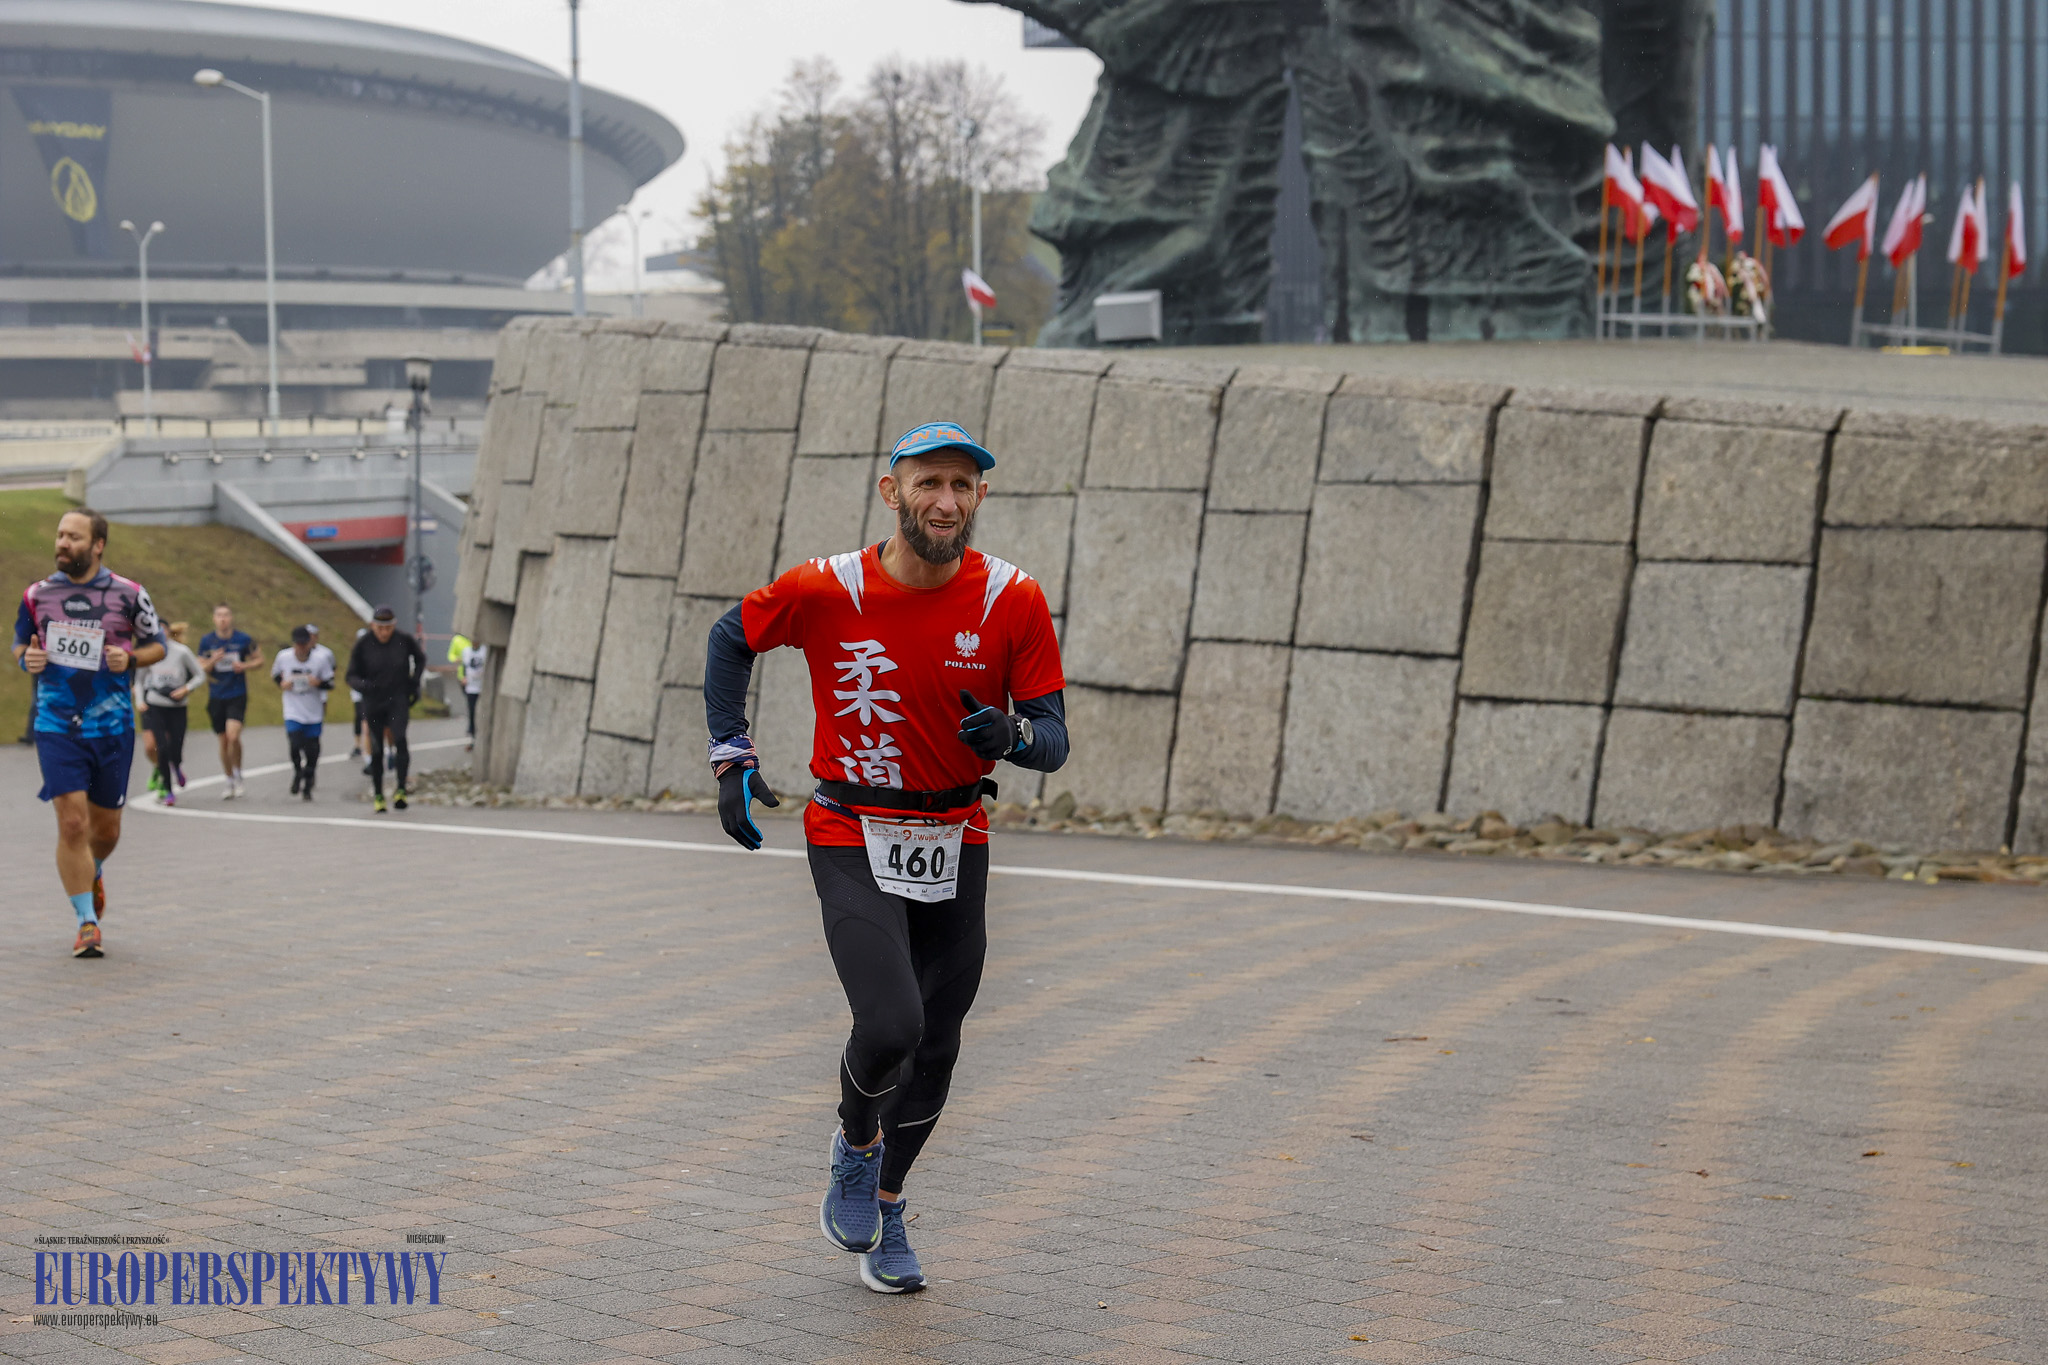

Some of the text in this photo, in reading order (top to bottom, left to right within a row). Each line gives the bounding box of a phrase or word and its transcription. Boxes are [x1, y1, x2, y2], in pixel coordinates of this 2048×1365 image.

[57, 637, 90, 656] 560
[944, 660, 986, 671] POLAND
[833, 639, 907, 790] 柔道
[888, 844, 945, 879] 460
